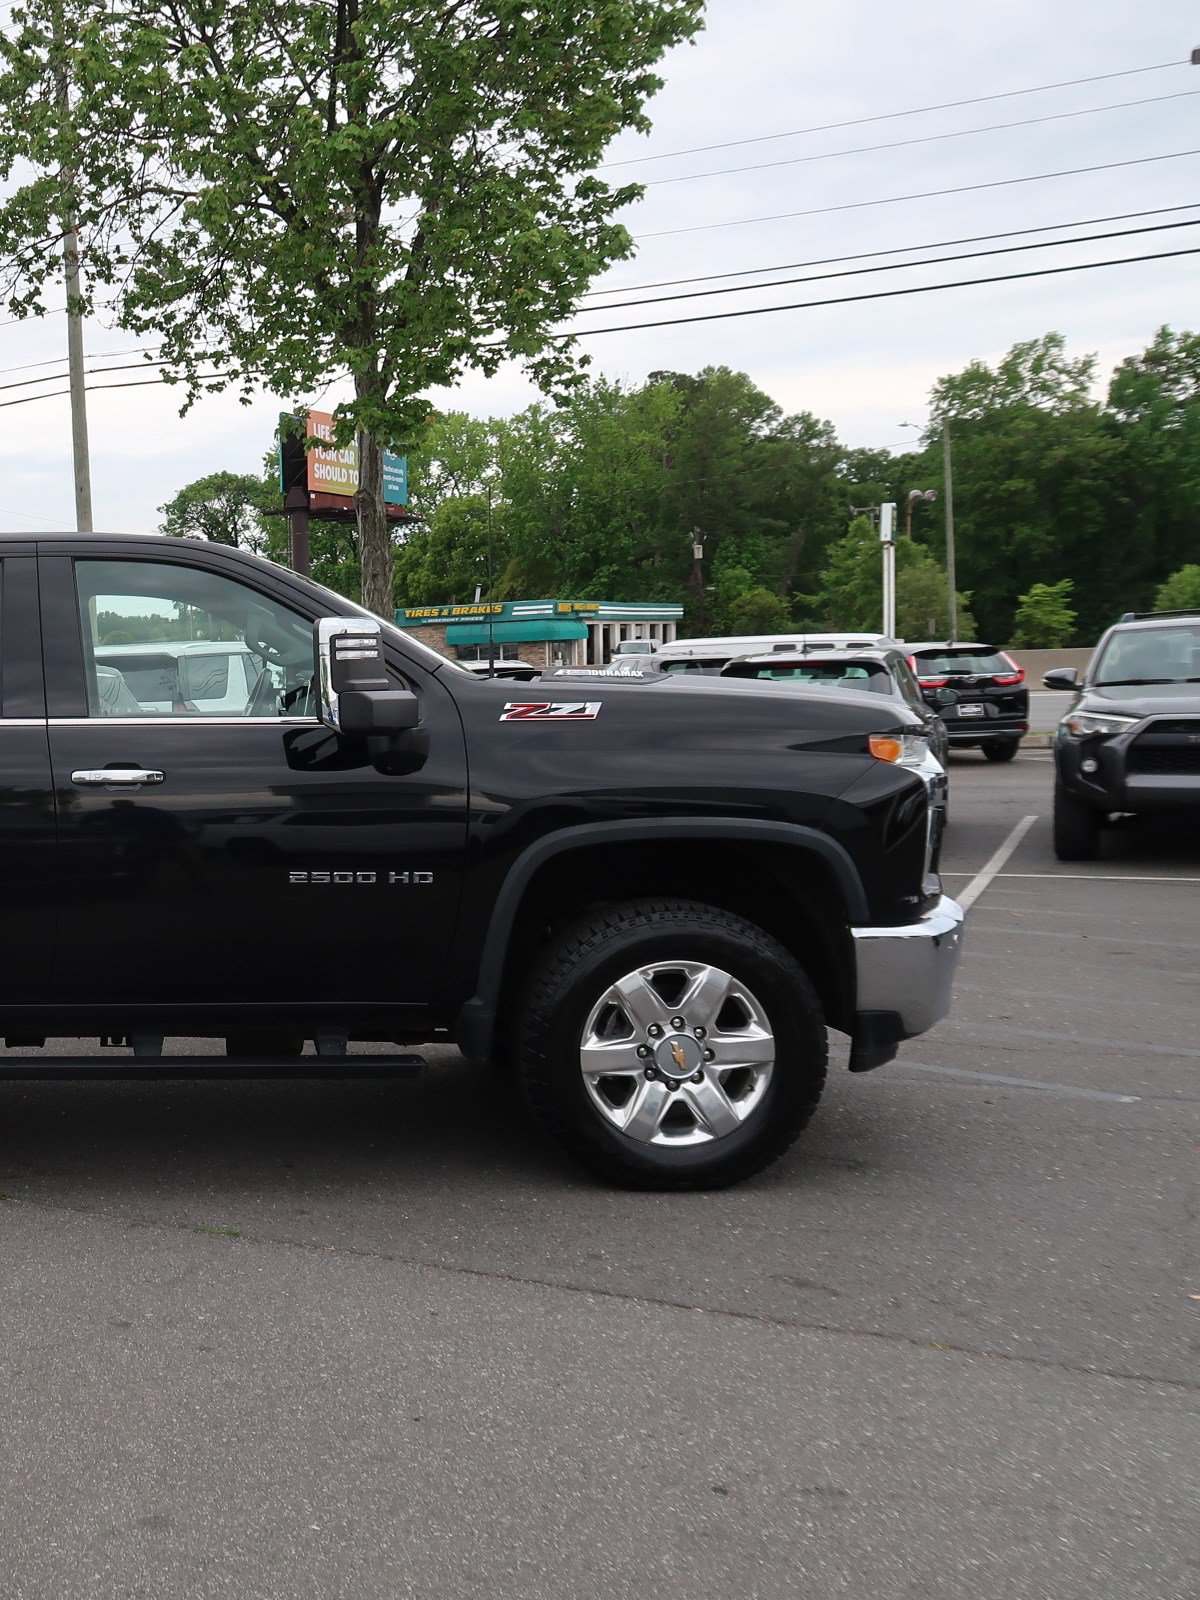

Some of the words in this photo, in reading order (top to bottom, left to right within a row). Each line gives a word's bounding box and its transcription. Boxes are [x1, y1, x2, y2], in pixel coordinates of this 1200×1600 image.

[313, 422, 330, 441] LIFE
[338, 447, 355, 466] CAR
[314, 463, 347, 482] SHOULD
[404, 608, 439, 618] TIRES
[441, 608, 449, 616] &
[451, 604, 503, 616] BRAKES
[591, 669, 644, 678] DURAMAX
[499, 702, 603, 721] Z71
[289, 871, 376, 884] 2500
[388, 871, 434, 884] HD
